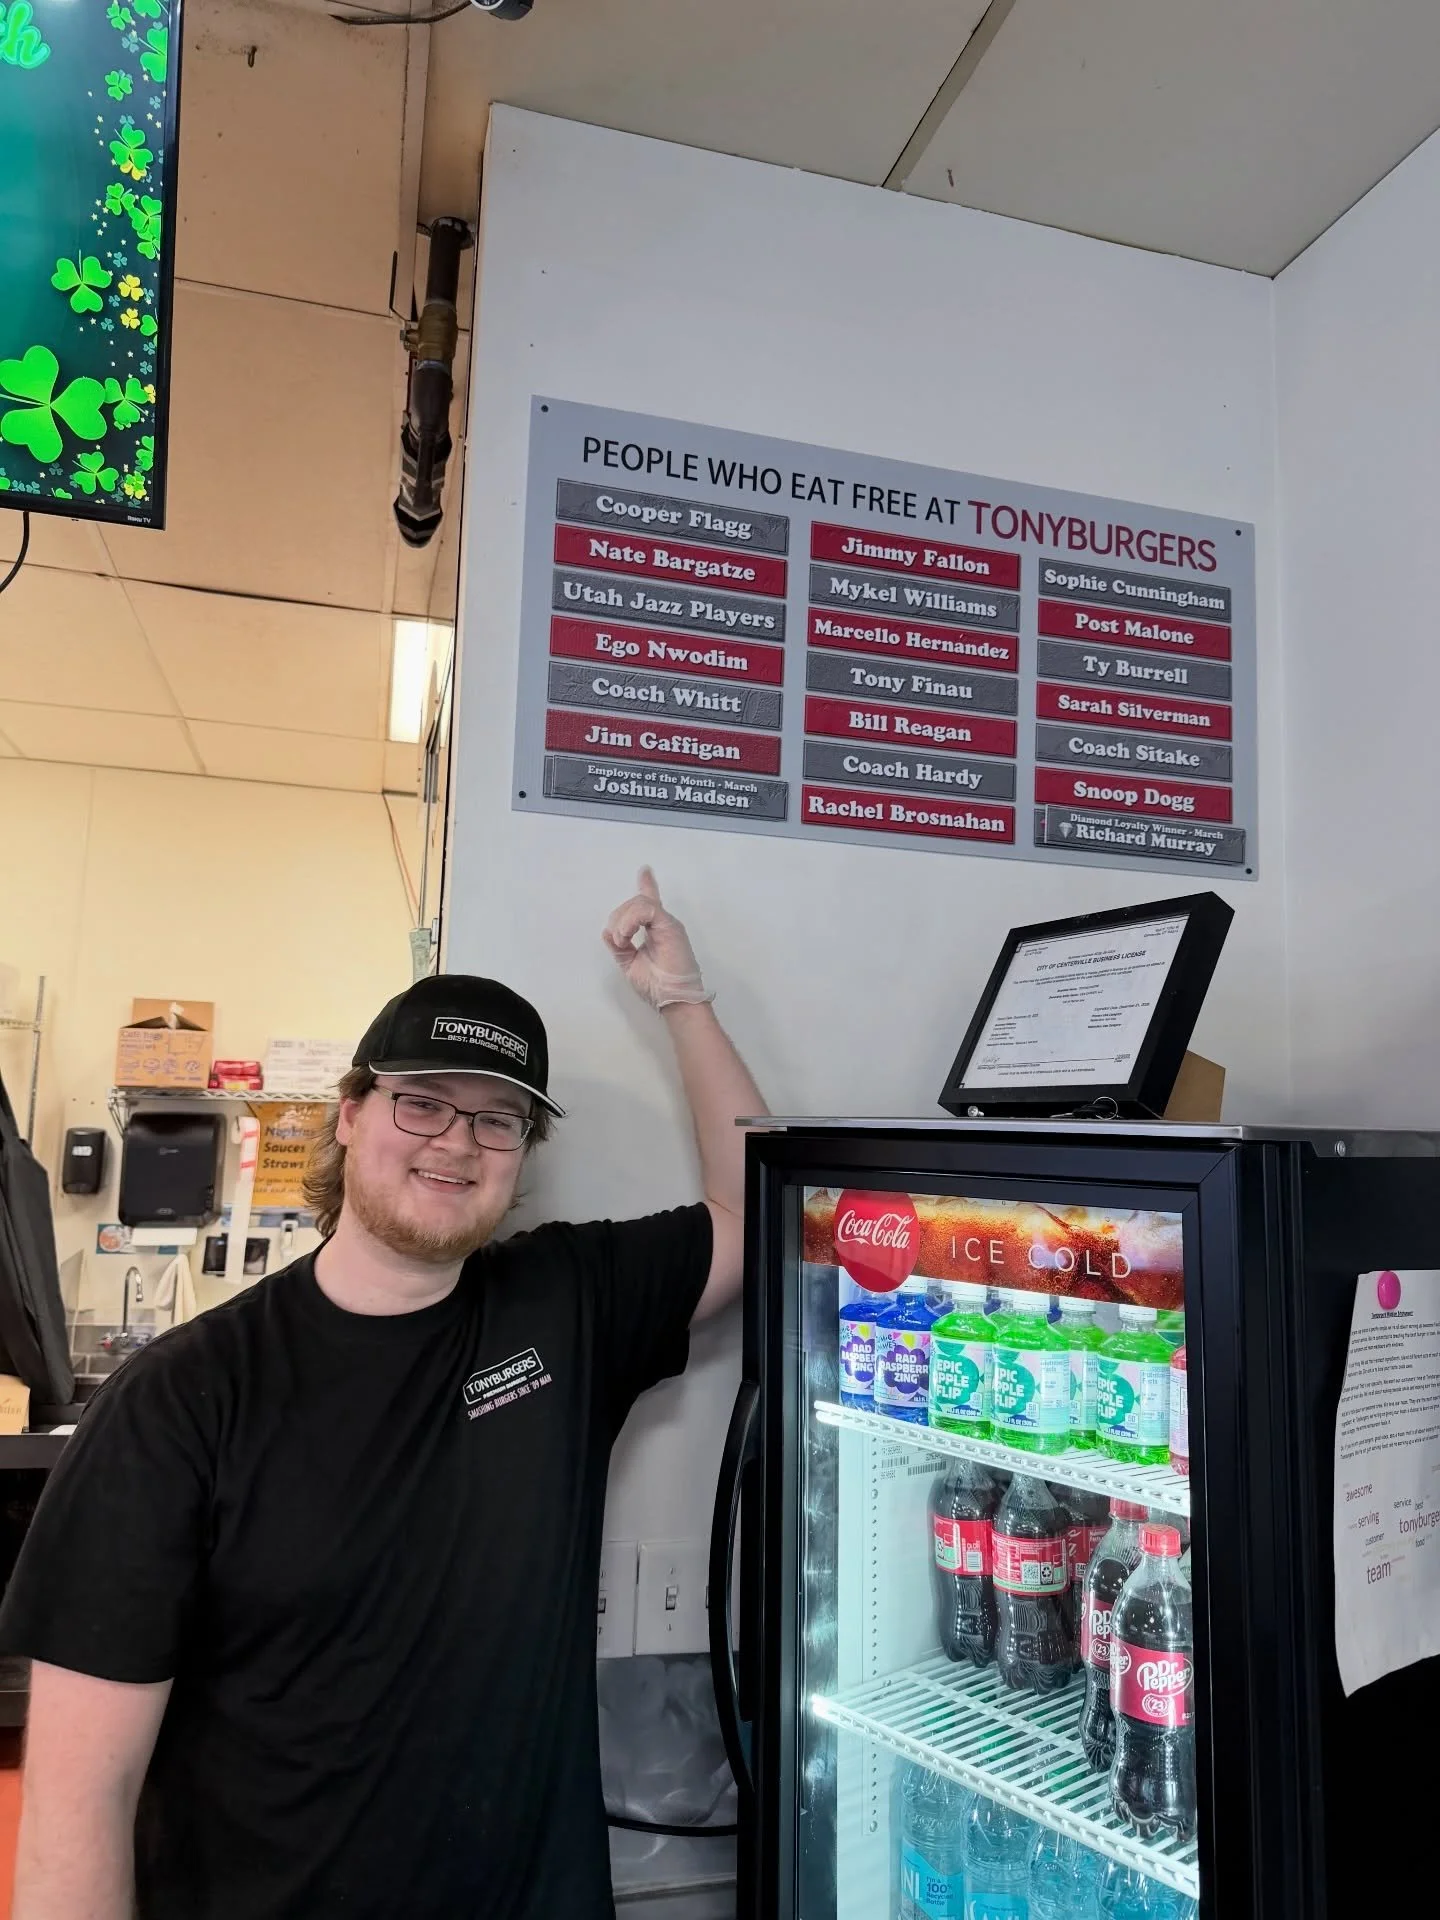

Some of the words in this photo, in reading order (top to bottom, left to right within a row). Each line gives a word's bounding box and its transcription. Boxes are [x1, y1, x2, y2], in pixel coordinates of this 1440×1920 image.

[583, 436, 700, 482] PEOPLE
[707, 456, 782, 496] WHO
[791, 472, 844, 508] EAT
[852, 483, 917, 520] FREE
[924, 497, 960, 526] AT
[967, 500, 1218, 573] TONYBURGERS
[595, 495, 683, 524] Cooper
[688, 509, 753, 540] Flagg
[589, 538, 647, 565] Nate
[652, 548, 756, 582] Bargatze
[841, 536, 917, 568] Jimmy
[922, 548, 990, 576] Fallon
[562, 580, 624, 608] Utah
[629, 592, 684, 617] Jazz
[689, 600, 775, 630] Players
[829, 577, 898, 604] Mykel
[903, 587, 998, 618] Williams
[1044, 568, 1108, 593] Sophie
[1112, 579, 1226, 611] Cunningham
[814, 618, 900, 646] Marcello
[905, 631, 1010, 660] Hernández
[1074, 612, 1120, 634] Post
[1124, 620, 1195, 645] Malone
[595, 633, 640, 658] Ego
[647, 640, 749, 671] Nwodim
[849, 667, 906, 694] Tony
[911, 675, 974, 700] Finau
[1082, 655, 1111, 677] Ty
[1115, 659, 1189, 685] Burrell
[591, 677, 666, 705] Coach
[672, 686, 743, 713] Whitt
[1057, 694, 1113, 716] Sarah
[1118, 701, 1212, 728] Silverman
[584, 725, 633, 748] Jim
[639, 731, 741, 761] Gaffigan
[848, 711, 888, 732] Bill
[894, 717, 972, 743] Reagan
[1068, 736, 1131, 760] Coach
[1135, 744, 1201, 768] Sitake
[588, 764, 651, 782] Employee
[651, 771, 659, 782] of
[660, 772, 678, 783] the
[679, 774, 716, 789] Month
[724, 781, 758, 794] March
[842, 755, 910, 779] Coach
[915, 763, 983, 790] Hardy
[593, 776, 669, 801] Joshua
[674, 784, 750, 809] Madsen
[1073, 780, 1139, 807] Snoop
[1144, 788, 1196, 813] Dogg
[807, 794, 884, 821] Rachel
[890, 804, 1006, 833] Brosnahan
[1070, 813, 1113, 827] Diamond
[1115, 819, 1150, 833] Loyalty
[1152, 823, 1187, 836] Winner
[1194, 828, 1224, 840] March
[1075, 824, 1146, 846] Richard
[1151, 833, 1217, 857] Murray
[1036, 964, 1048, 972] CITY
[1057, 957, 1092, 970] CENTERVILLE
[1093, 953, 1120, 964] BUSINESS
[1121, 950, 1147, 960] LICENSE
[437, 1021, 526, 1057] TONYBURGERS
[263, 1158, 304, 1169] Straws
[264, 1142, 305, 1153] Sauces
[837, 1209, 914, 1250] Coca-Cola
[951, 1236, 1005, 1265] ICE
[1027, 1244, 1132, 1279] COLD
[852, 1343, 873, 1353] RAD
[895, 1353, 917, 1364] RAD
[465, 1356, 537, 1395] TONYBURGERS
[894, 1372, 918, 1384] ZING
[936, 1359, 963, 1375] EPIC
[467, 1400, 495, 1420] SMASHING
[494, 1389, 519, 1409] BURGERS
[517, 1383, 532, 1398] SINCE
[936, 1383, 962, 1400] FLIP
[1346, 1483, 1373, 1503] awesome
[1393, 1498, 1412, 1509] service
[1358, 1512, 1380, 1529] serving
[1415, 1538, 1425, 1548] food
[1366, 1560, 1391, 1585] team
[1098, 1646, 1107, 1656] 23
[1158, 1660, 1179, 1674] Dr
[1143, 1662, 1191, 1693] Pepper
[1151, 1701, 1164, 1710] 23
